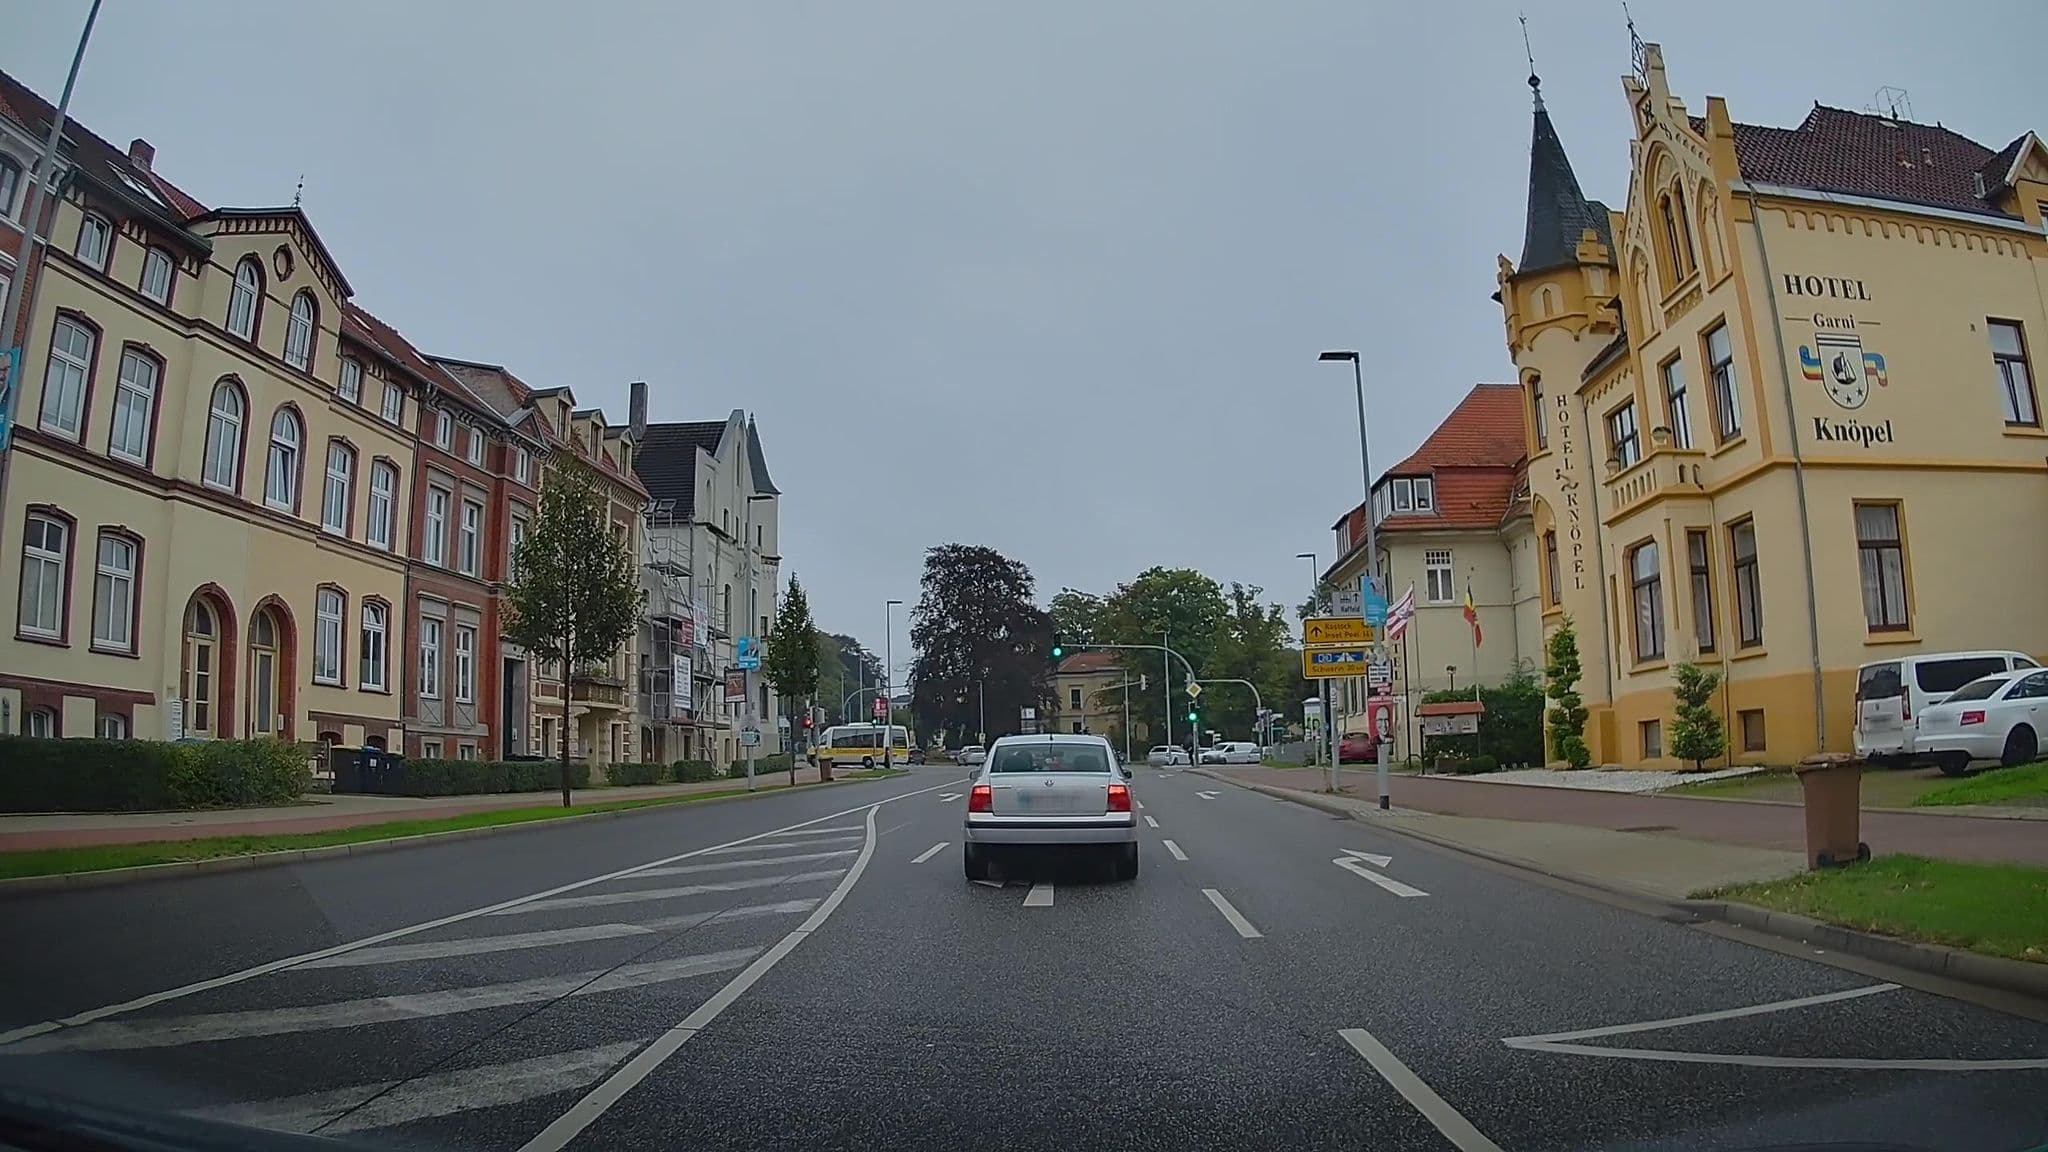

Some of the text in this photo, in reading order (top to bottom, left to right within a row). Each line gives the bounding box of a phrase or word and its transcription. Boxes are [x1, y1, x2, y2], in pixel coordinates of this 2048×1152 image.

[1783, 273, 1872, 301] HOTEL
[1813, 312, 1855, 329] Garni
[1556, 394, 1574, 471] HOTEL
[1813, 417, 1894, 449] Knöpel
[1566, 492, 1585, 590] KNÖPEL
